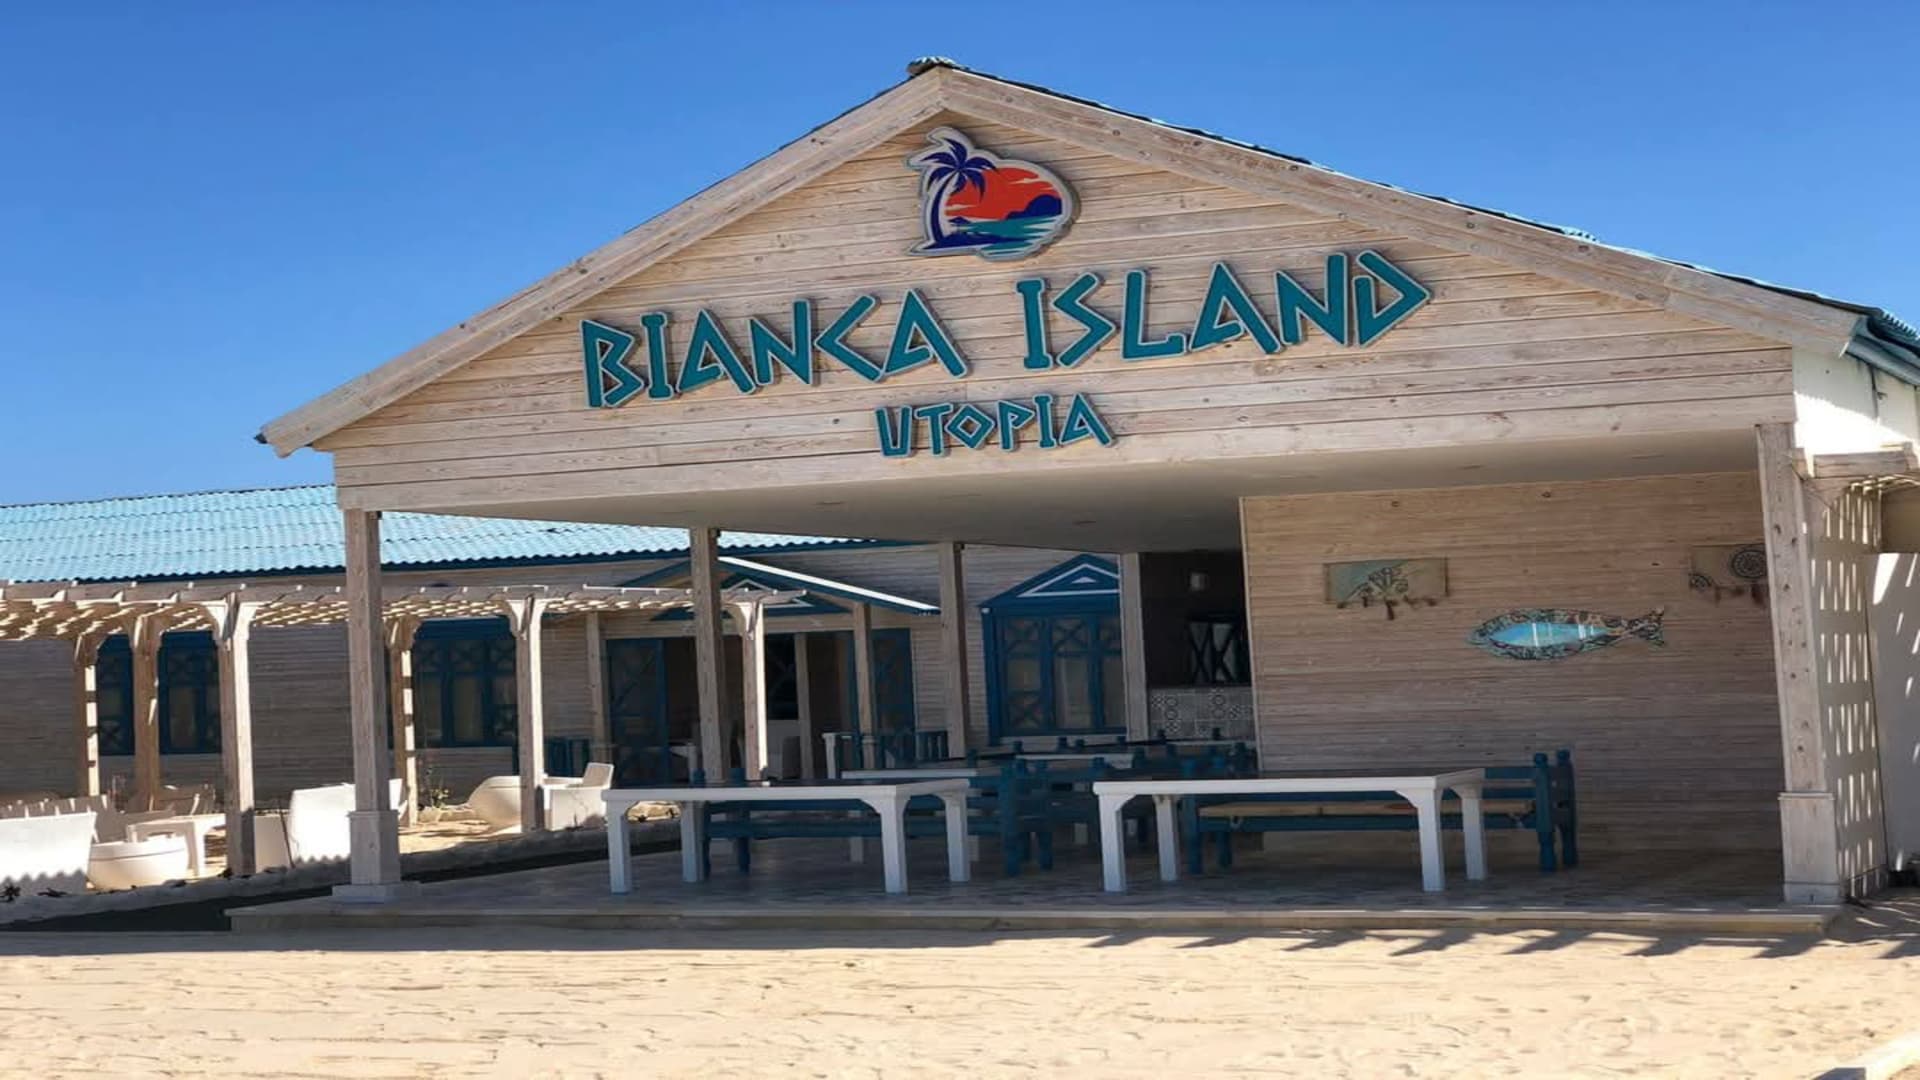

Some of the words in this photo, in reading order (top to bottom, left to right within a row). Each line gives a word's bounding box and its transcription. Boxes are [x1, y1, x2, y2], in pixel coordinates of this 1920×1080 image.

[581, 289, 968, 408] BIANCA
[1016, 250, 1430, 369] ISLAND
[875, 394, 1115, 455] UTOPIA
